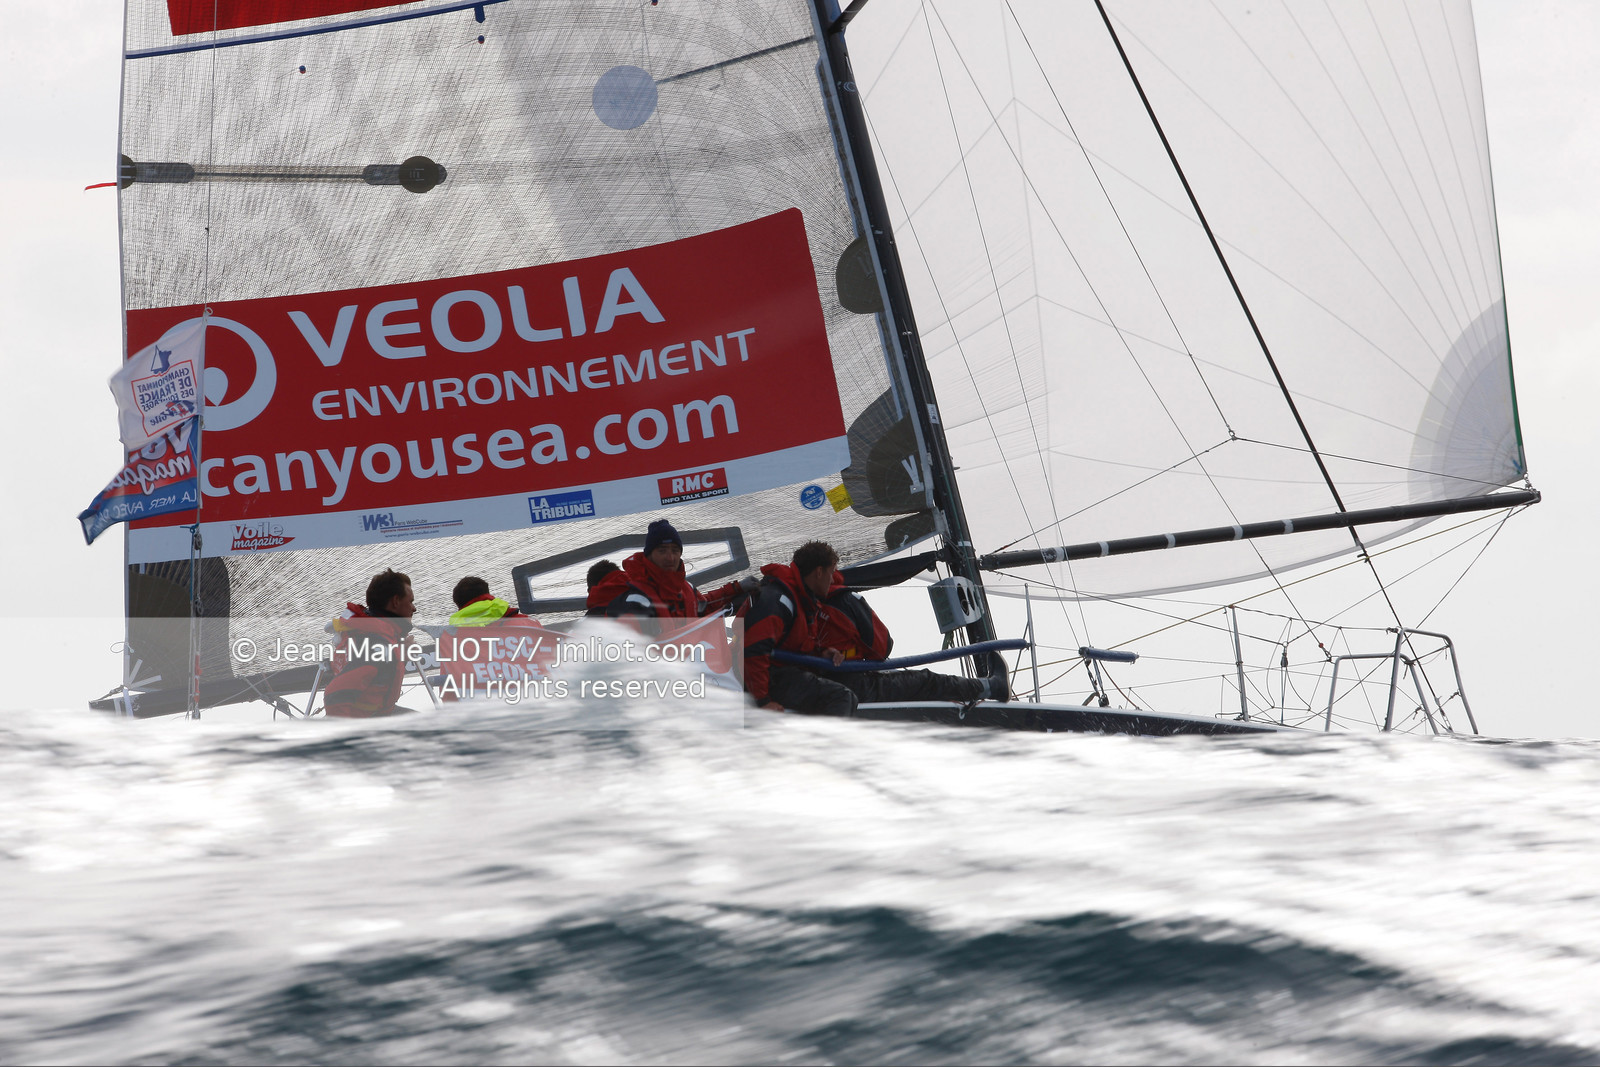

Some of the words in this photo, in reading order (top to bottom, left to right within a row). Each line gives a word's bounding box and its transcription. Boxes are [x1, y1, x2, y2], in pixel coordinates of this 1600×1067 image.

[287, 267, 666, 367] VEOLIA
[312, 328, 756, 421] ENVIRONNEMENT
[200, 395, 740, 506] canyousea.com
[672, 472, 714, 494] RMC
[530, 497, 550, 510] LA
[681, 493, 701, 501] TALK
[701, 488, 728, 497] SPORT
[532, 502, 593, 520] TRIBUNE
[231, 521, 284, 540] Voile
[233, 536, 285, 552] magazine
